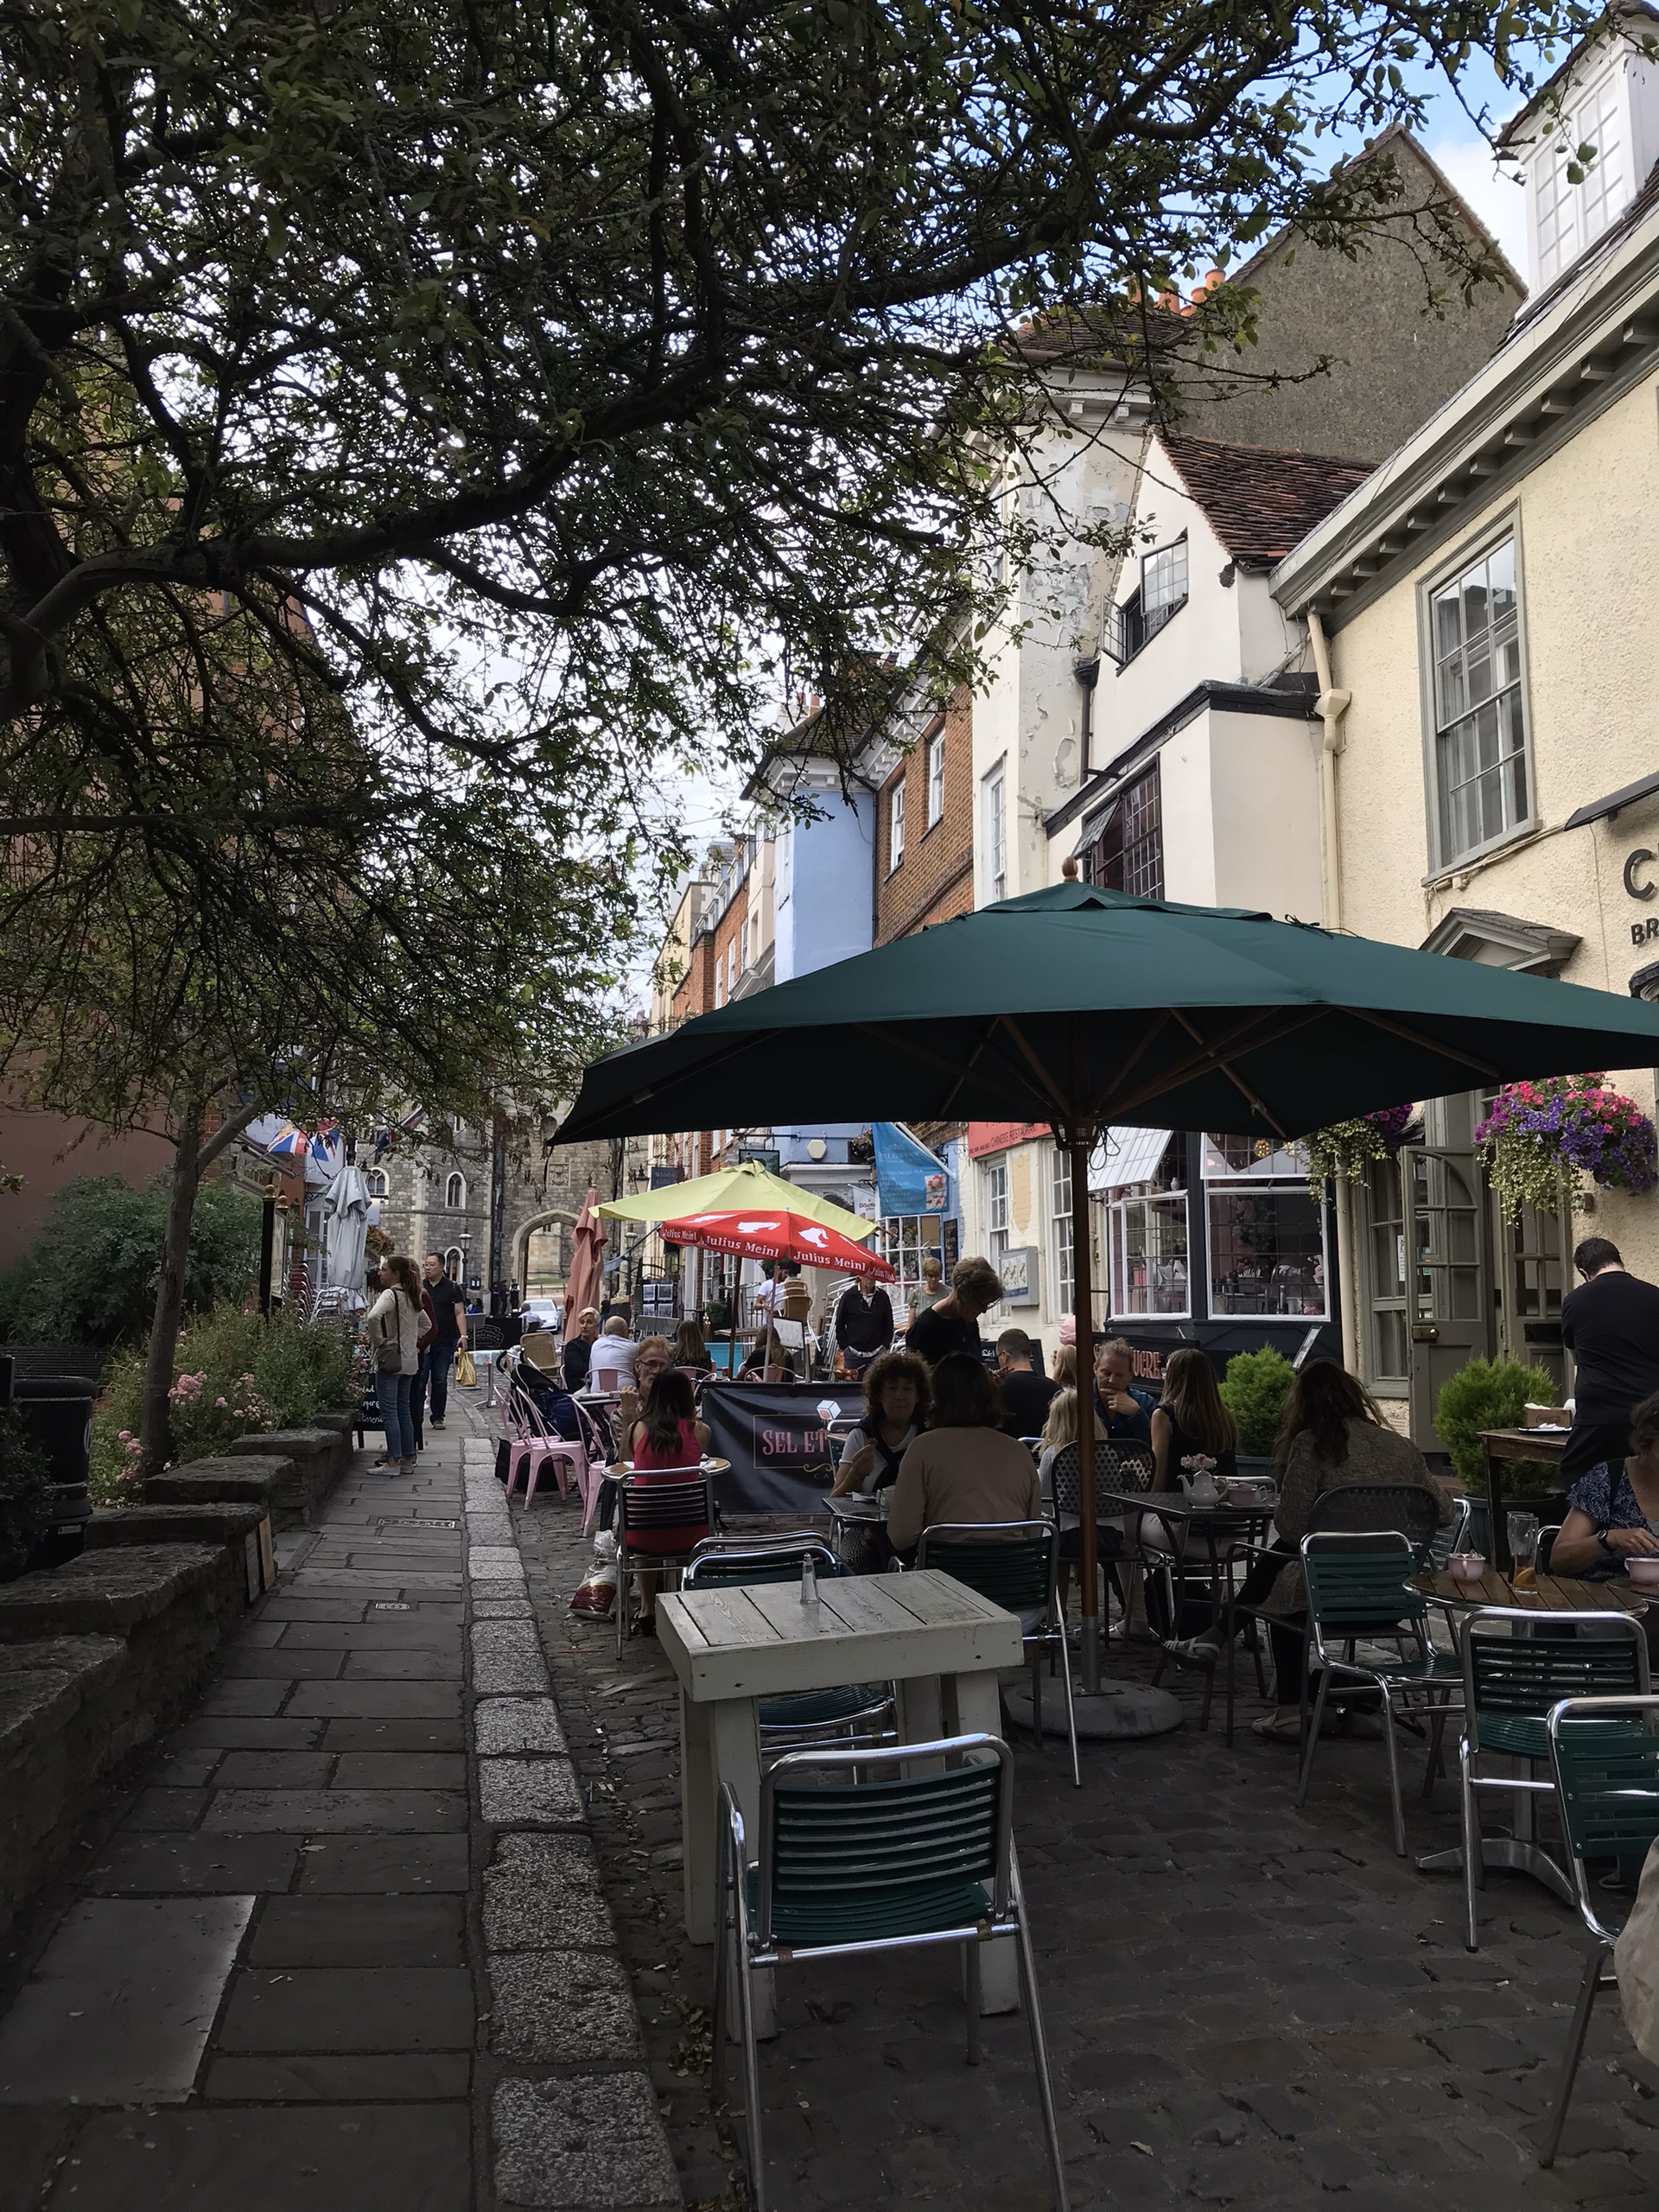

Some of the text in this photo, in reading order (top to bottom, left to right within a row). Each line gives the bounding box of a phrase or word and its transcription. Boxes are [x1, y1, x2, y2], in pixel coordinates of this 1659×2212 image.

[1624, 847, 1659, 899] C
[990, 1132, 1009, 1147] CHINESE
[1009, 1127, 1038, 1141] RESTAURANT
[663, 1229, 696, 1241] Julius Meinl
[706, 1235, 779, 1258] Julius Meinl
[793, 1250, 866, 1271] Julius Meinl
[1130, 1347, 1162, 1380] UCRE
[761, 1428, 828, 1456] SEL ET
